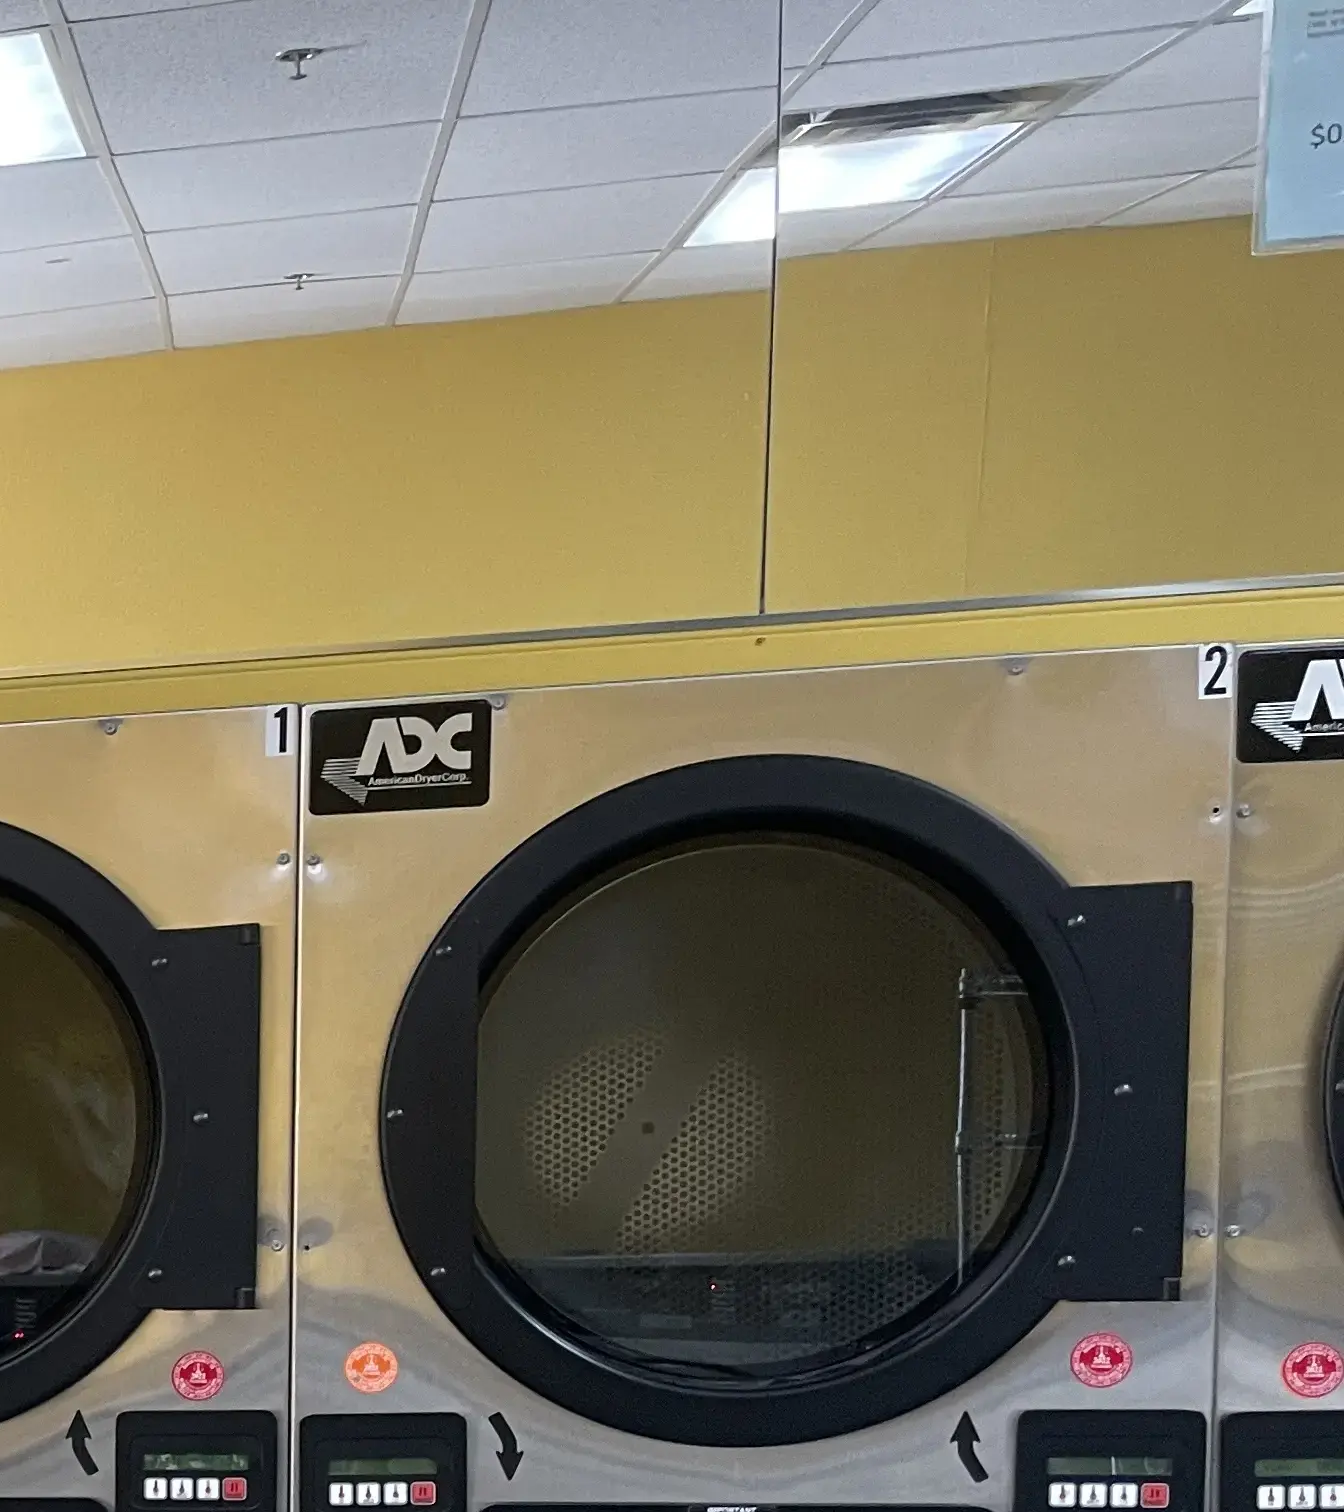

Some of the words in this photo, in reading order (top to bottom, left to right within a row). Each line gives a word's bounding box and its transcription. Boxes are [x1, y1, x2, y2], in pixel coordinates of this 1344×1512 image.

[1203, 645, 1228, 696] 2
[1291, 658, 1344, 721] A
[274, 706, 288, 754] 1
[354, 712, 473, 776] ADC
